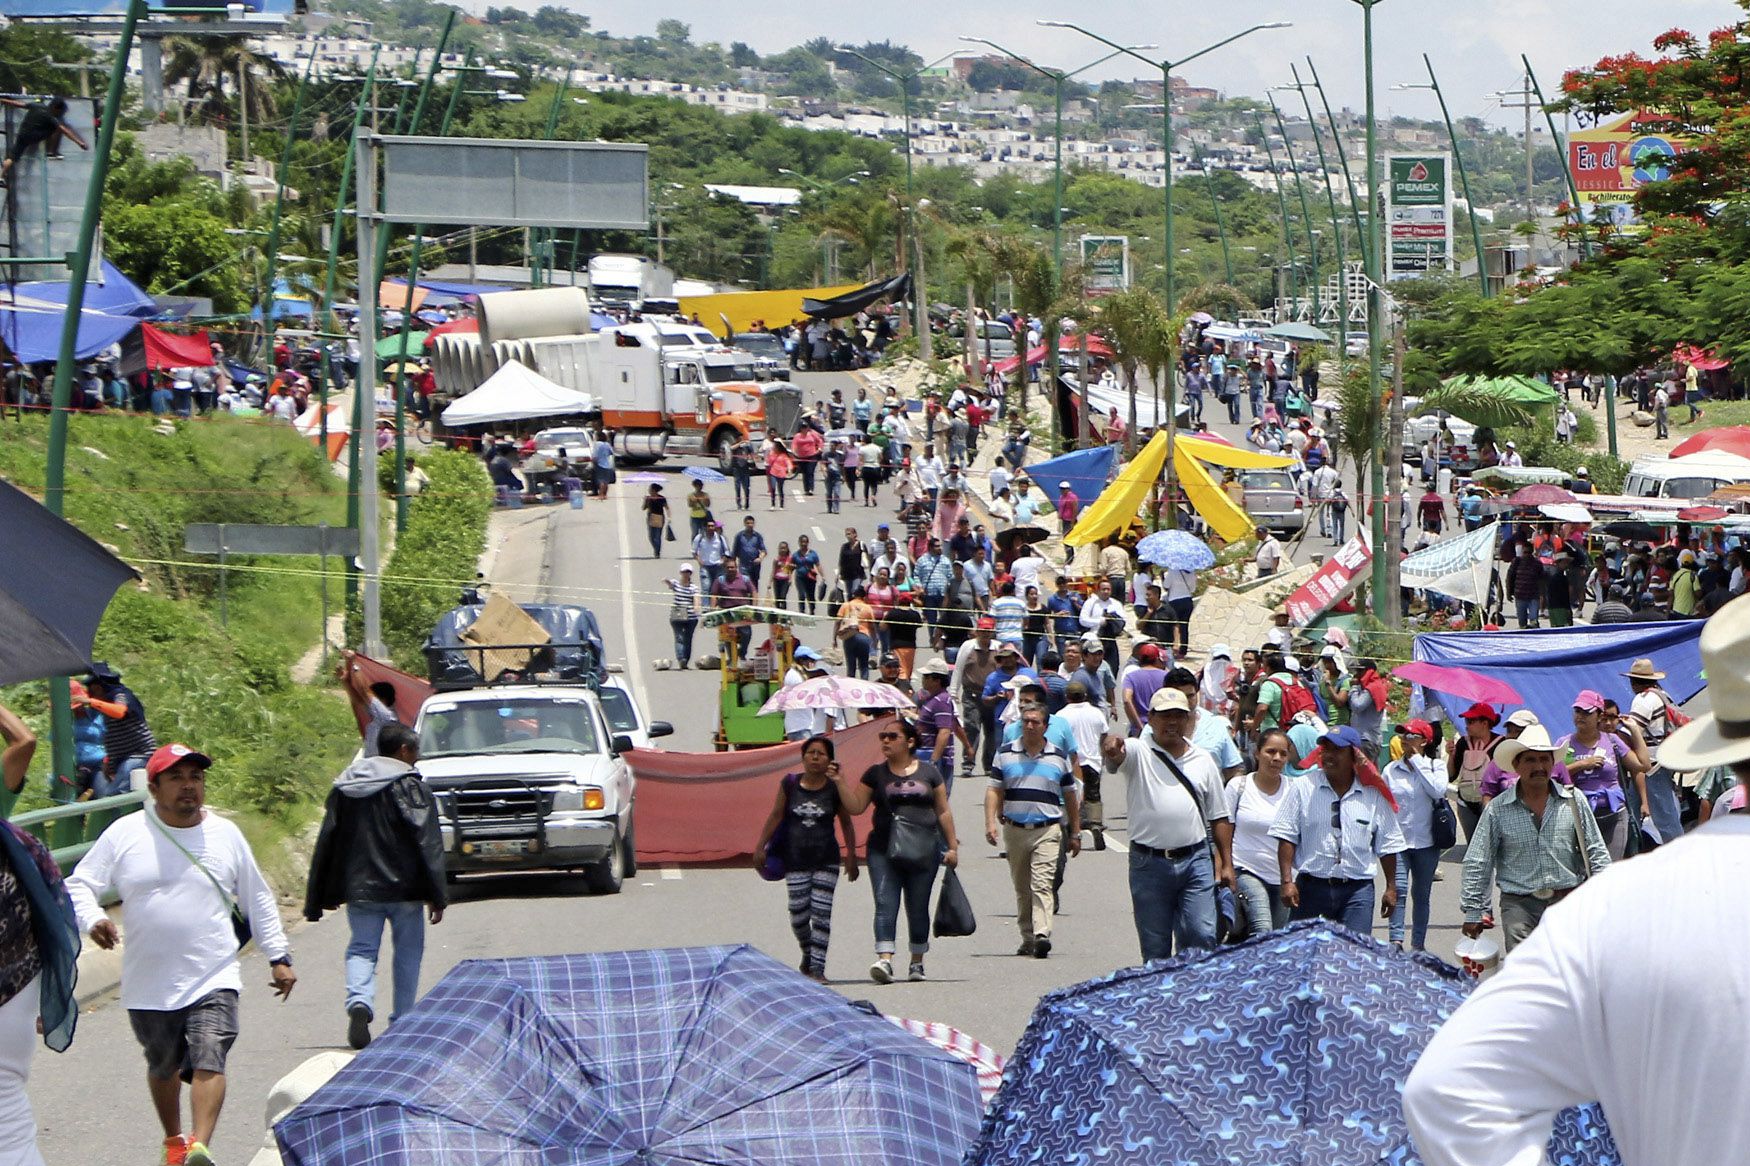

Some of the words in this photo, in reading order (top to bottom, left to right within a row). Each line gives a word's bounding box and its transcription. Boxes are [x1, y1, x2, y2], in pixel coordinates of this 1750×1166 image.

[1577, 145, 1597, 170] En
[1601, 143, 1617, 169] el
[1396, 182, 1440, 192] PEMEX
[1413, 226, 1445, 236] Premium
[1413, 258, 1438, 267] Dieel
